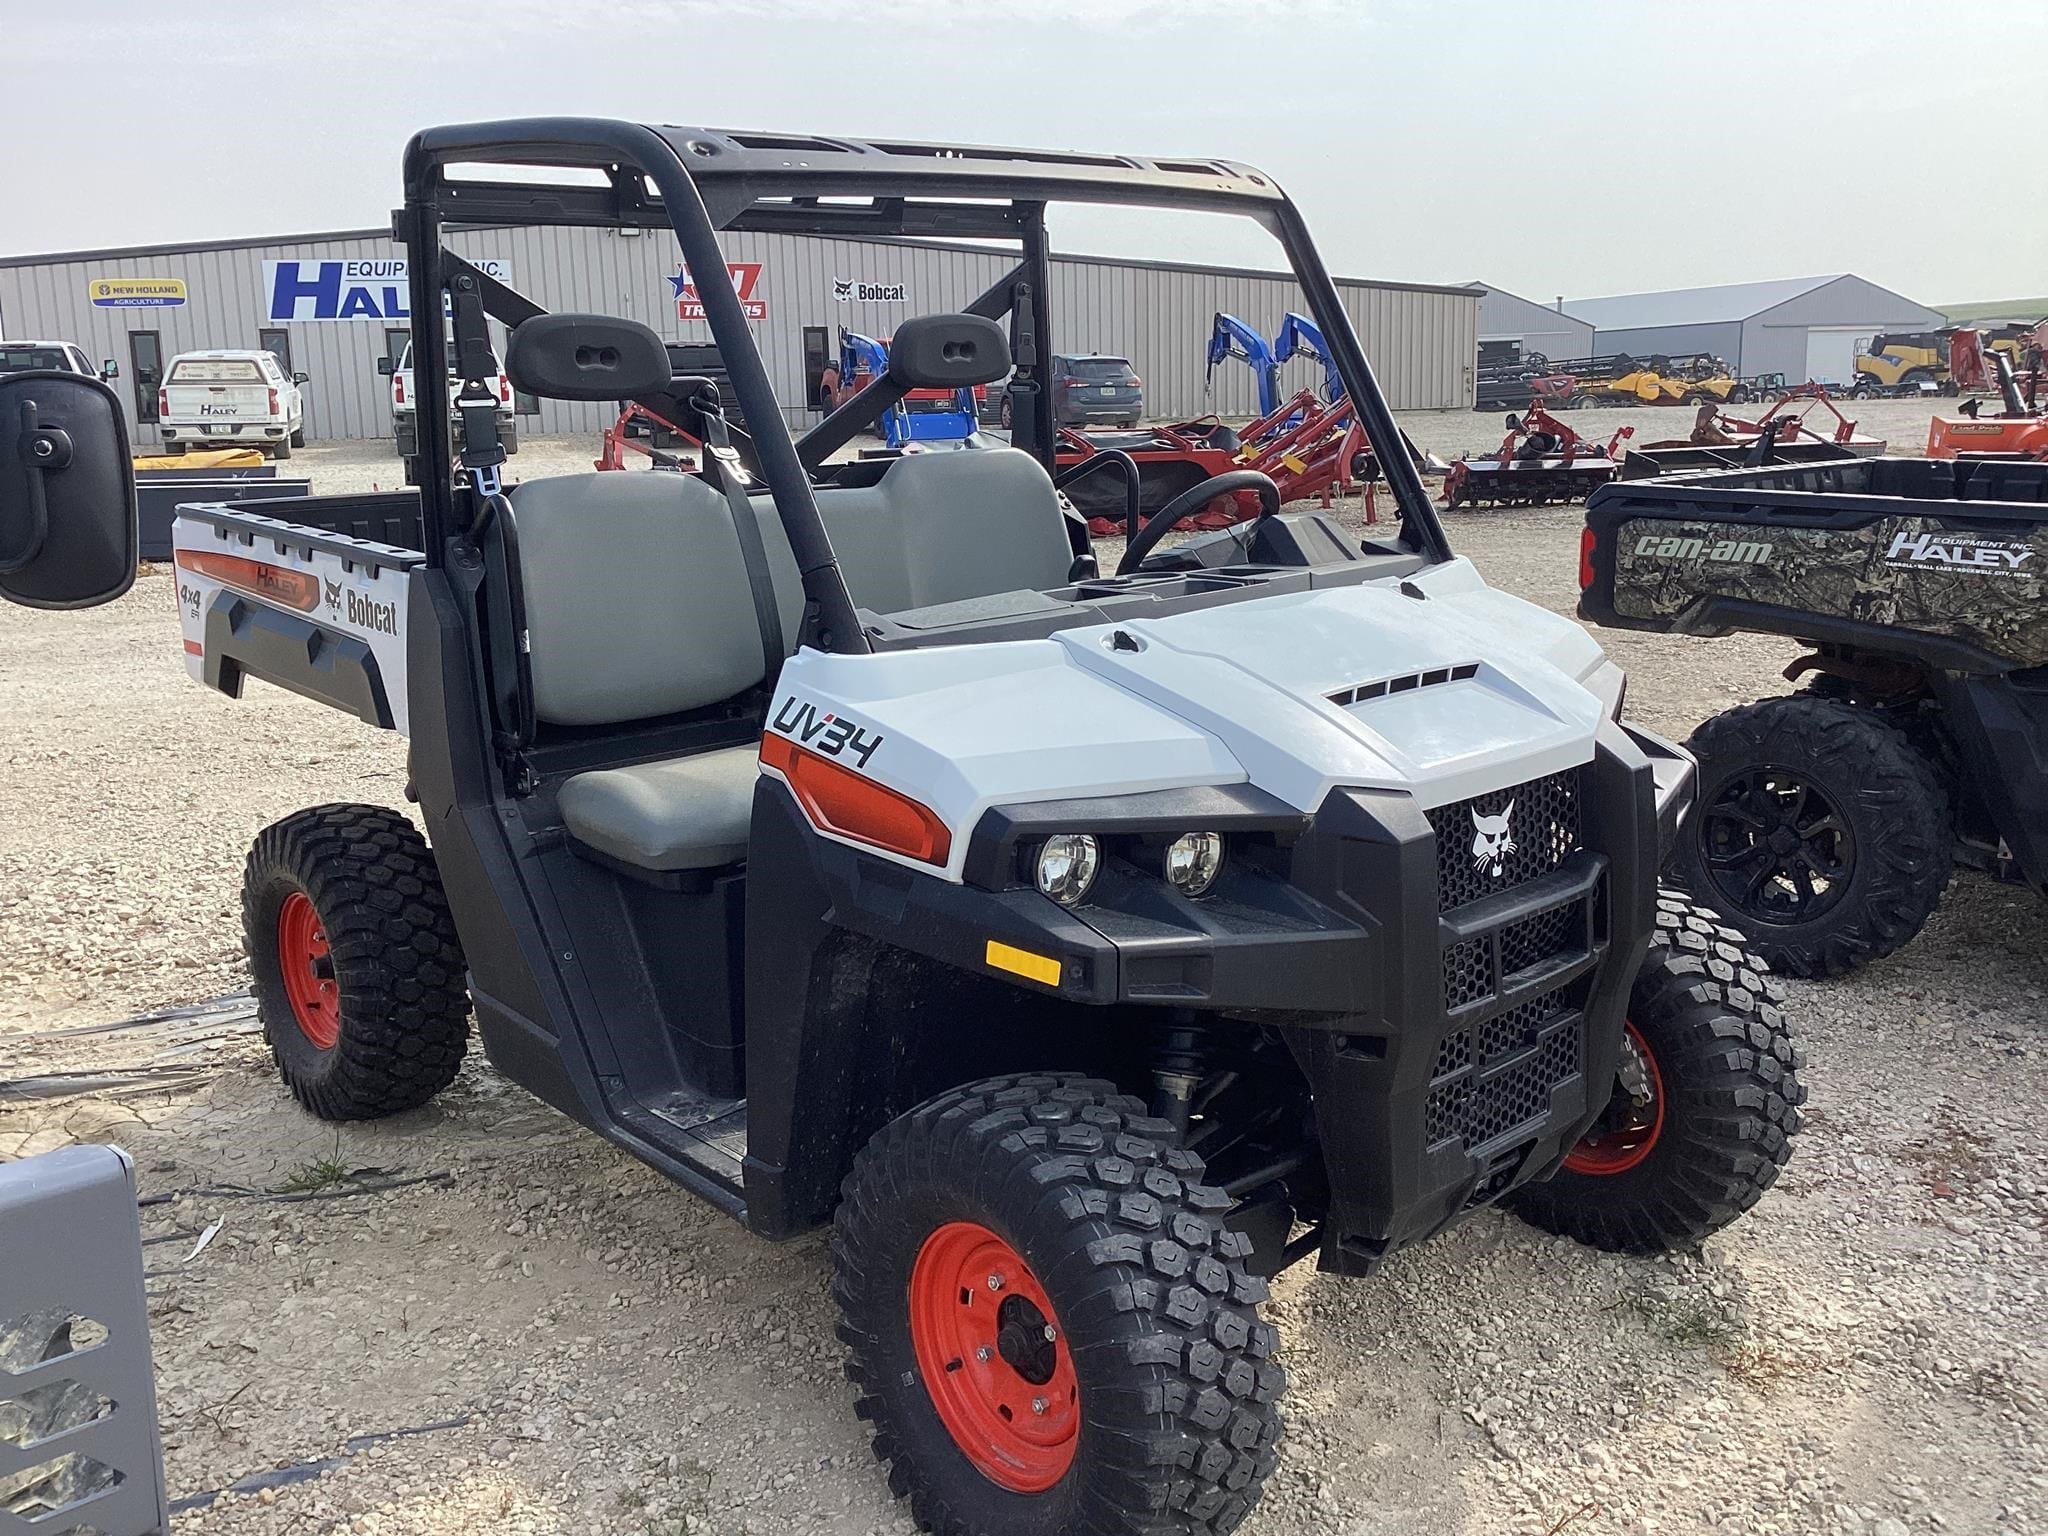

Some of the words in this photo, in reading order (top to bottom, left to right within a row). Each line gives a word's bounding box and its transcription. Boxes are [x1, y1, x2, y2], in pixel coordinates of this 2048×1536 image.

[473, 261, 503, 276] NC.
[136, 286, 178, 294] HOLLAND
[858, 284, 905, 300] Bobcat
[683, 305, 762, 316] TRRS
[200, 404, 237, 415] HALEY
[1634, 535, 1773, 564] can-am
[1886, 531, 2036, 569] HALEY
[1932, 537, 2007, 549] EQUIPMENT
[2010, 543, 2036, 551] INC.
[256, 565, 299, 596] HALEY
[180, 584, 201, 610] 4x4
[347, 589, 398, 637] Bobcat
[773, 696, 884, 769] UV34
